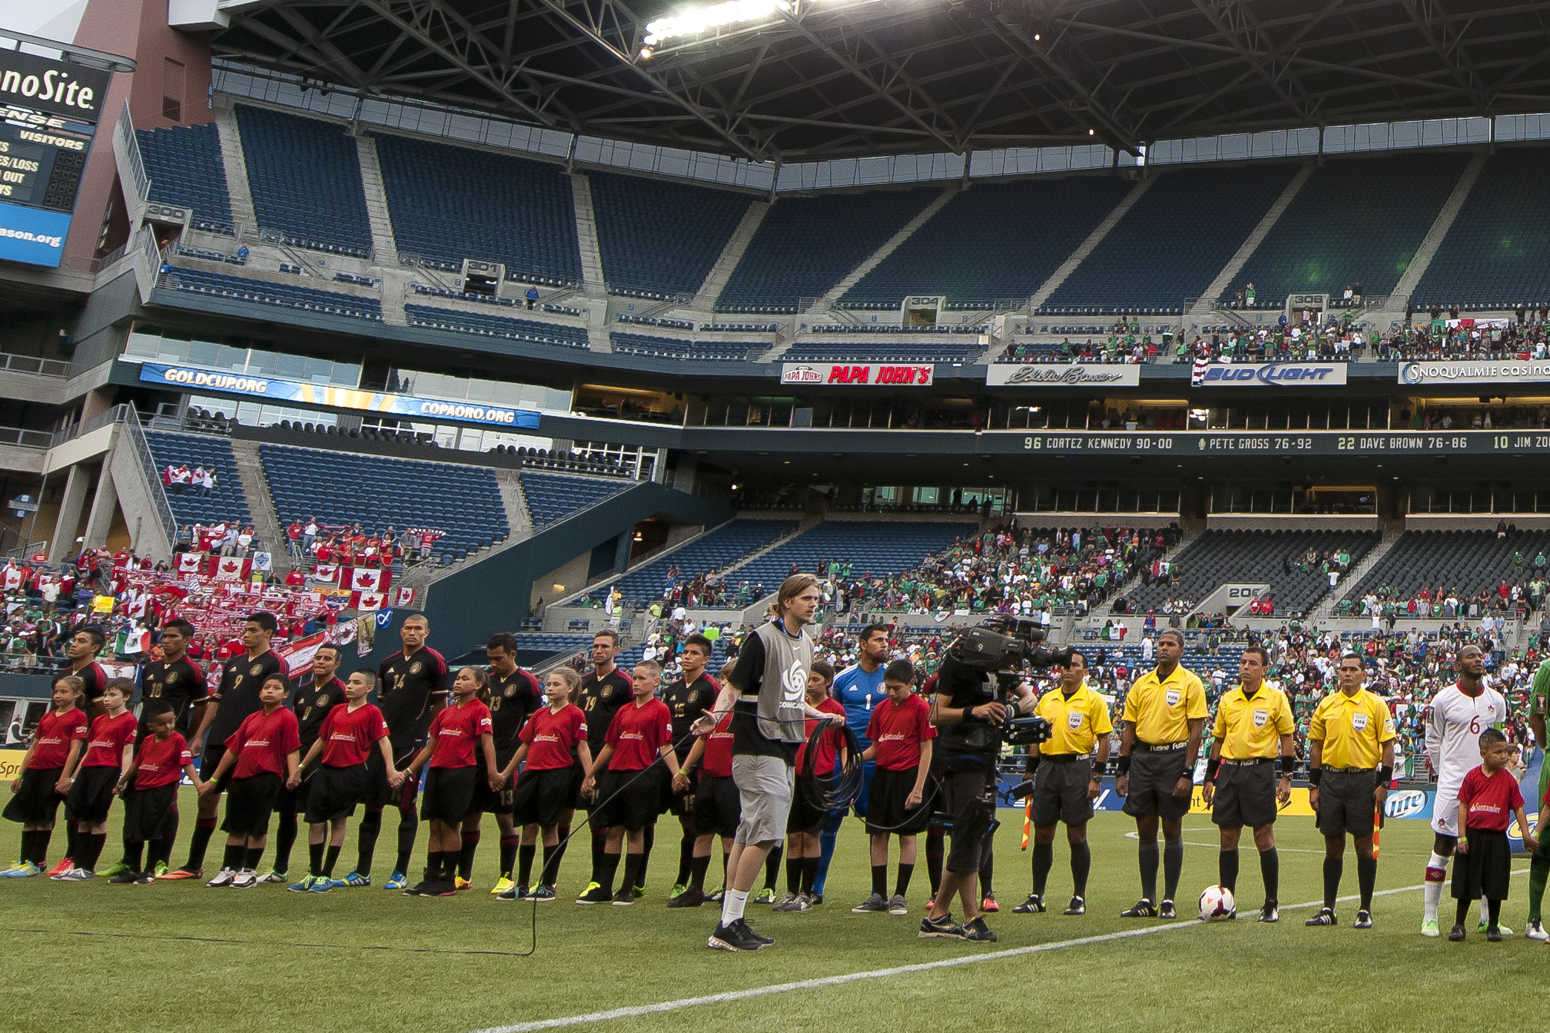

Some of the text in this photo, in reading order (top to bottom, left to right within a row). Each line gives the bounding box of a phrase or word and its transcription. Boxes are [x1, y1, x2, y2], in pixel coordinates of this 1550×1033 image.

[0, 69, 94, 110] noSite
[19, 129, 84, 151] VISITORS
[147, 204, 186, 217] 300
[467, 261, 498, 273] 301
[827, 365, 931, 384] PAPA JOHN'S
[1003, 366, 1063, 384] Eddie
[1204, 366, 1334, 381] BUD LIGHT
[1410, 364, 1497, 380] SNOQUALMIE
[164, 368, 268, 394] GOLDCUP.ORG
[420, 401, 515, 424] COPAORO.ORG
[1023, 437, 1042, 450] 96
[1046, 437, 1083, 449] CORTEZ
[1087, 437, 1132, 449] KENNEDY
[1209, 438, 1235, 449] PETE
[1238, 438, 1270, 449] GROSS
[1337, 437, 1355, 450] 22
[1360, 437, 1386, 449] DAVE
[1389, 437, 1423, 449] BROWN
[1493, 436, 1509, 449] 10
[1514, 436, 1532, 448] JIM
[233, 674, 244, 690] 9
[489, 696, 502, 711] 13
[584, 695, 597, 712] 19
[865, 693, 872, 710] 1
[1167, 694, 1178, 702] FIFA
[673, 702, 685, 717] 15
[1254, 714, 1266, 722] FIFA
[1469, 714, 1480, 735] 6
[1475, 803, 1502, 814] Santander
